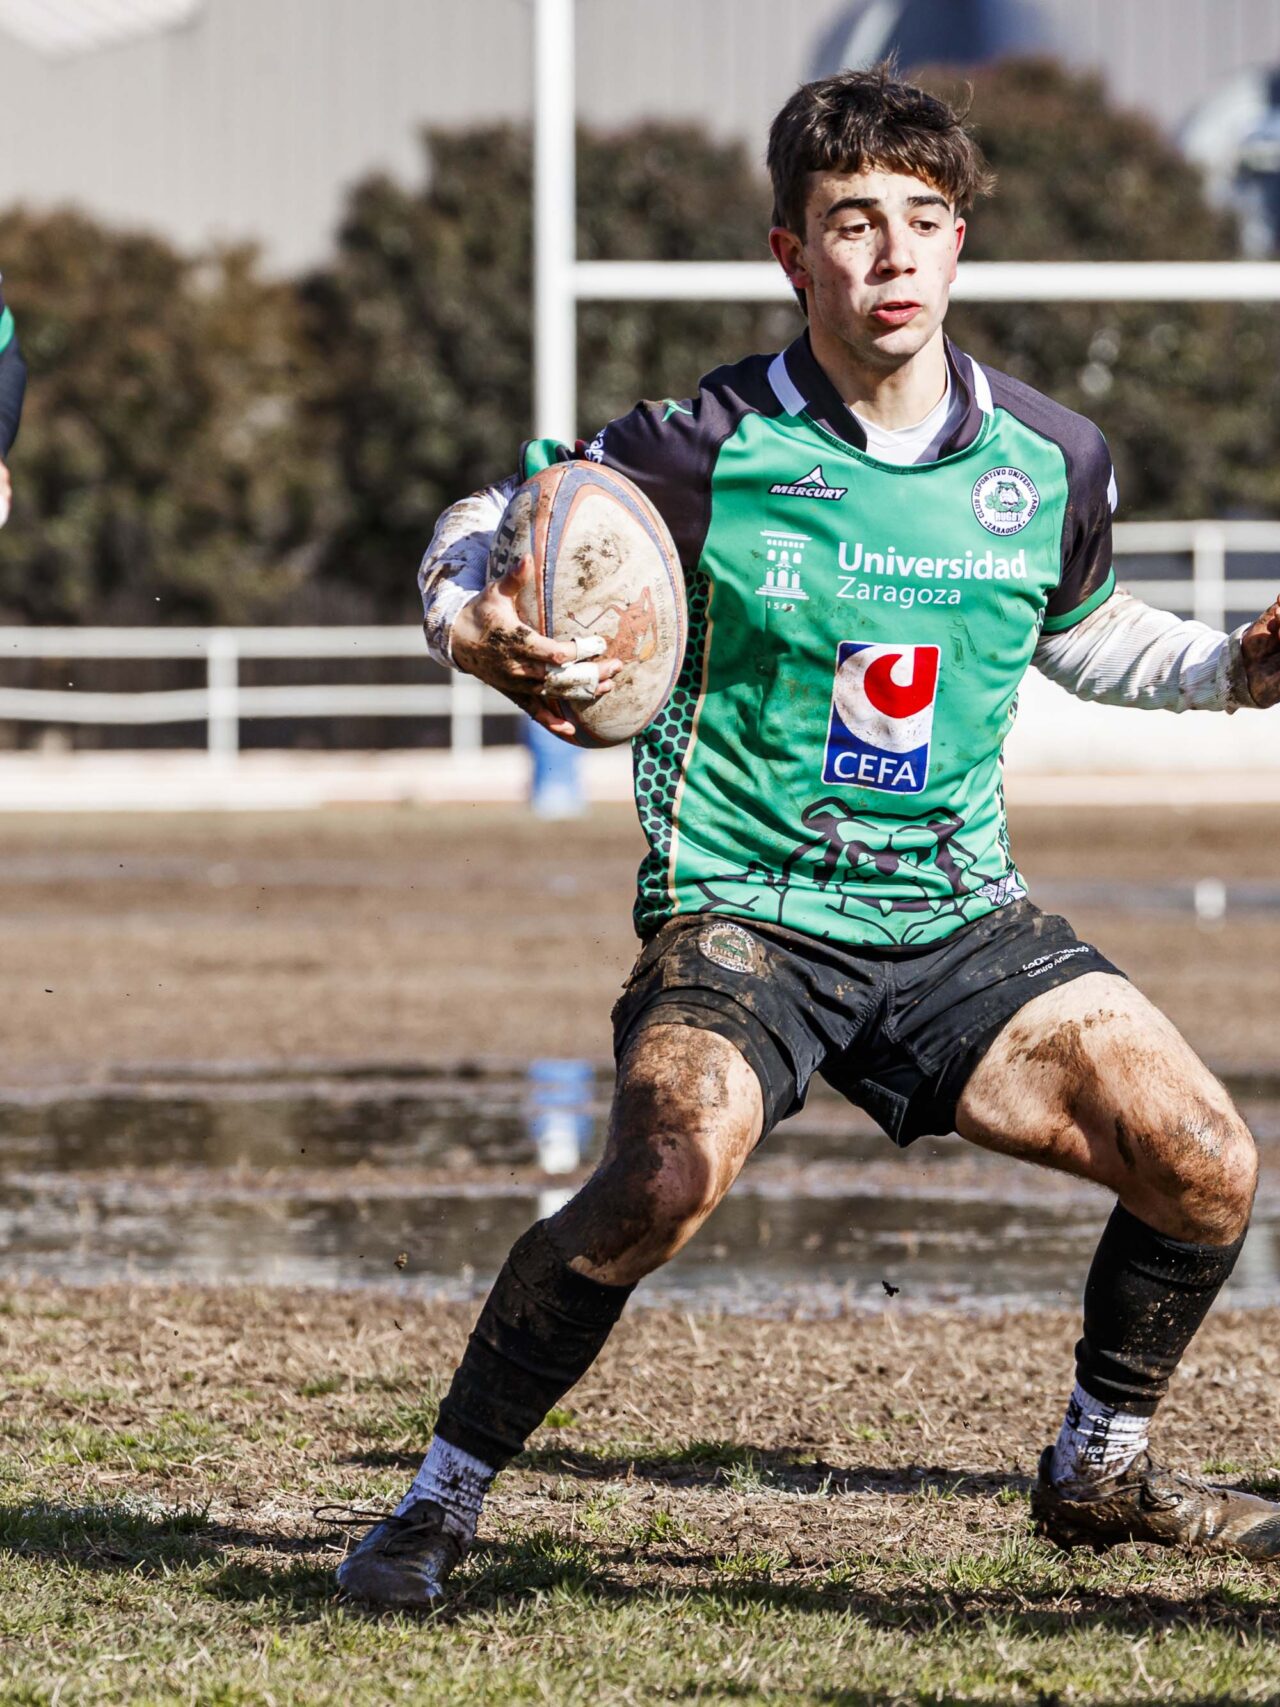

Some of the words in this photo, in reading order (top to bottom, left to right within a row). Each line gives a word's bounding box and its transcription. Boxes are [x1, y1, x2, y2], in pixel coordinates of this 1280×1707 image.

[770, 484, 847, 500] MERCURY
[838, 541, 1028, 580] Universidad
[836, 575, 962, 609] Zaragoza
[833, 751, 917, 788] CEFA
